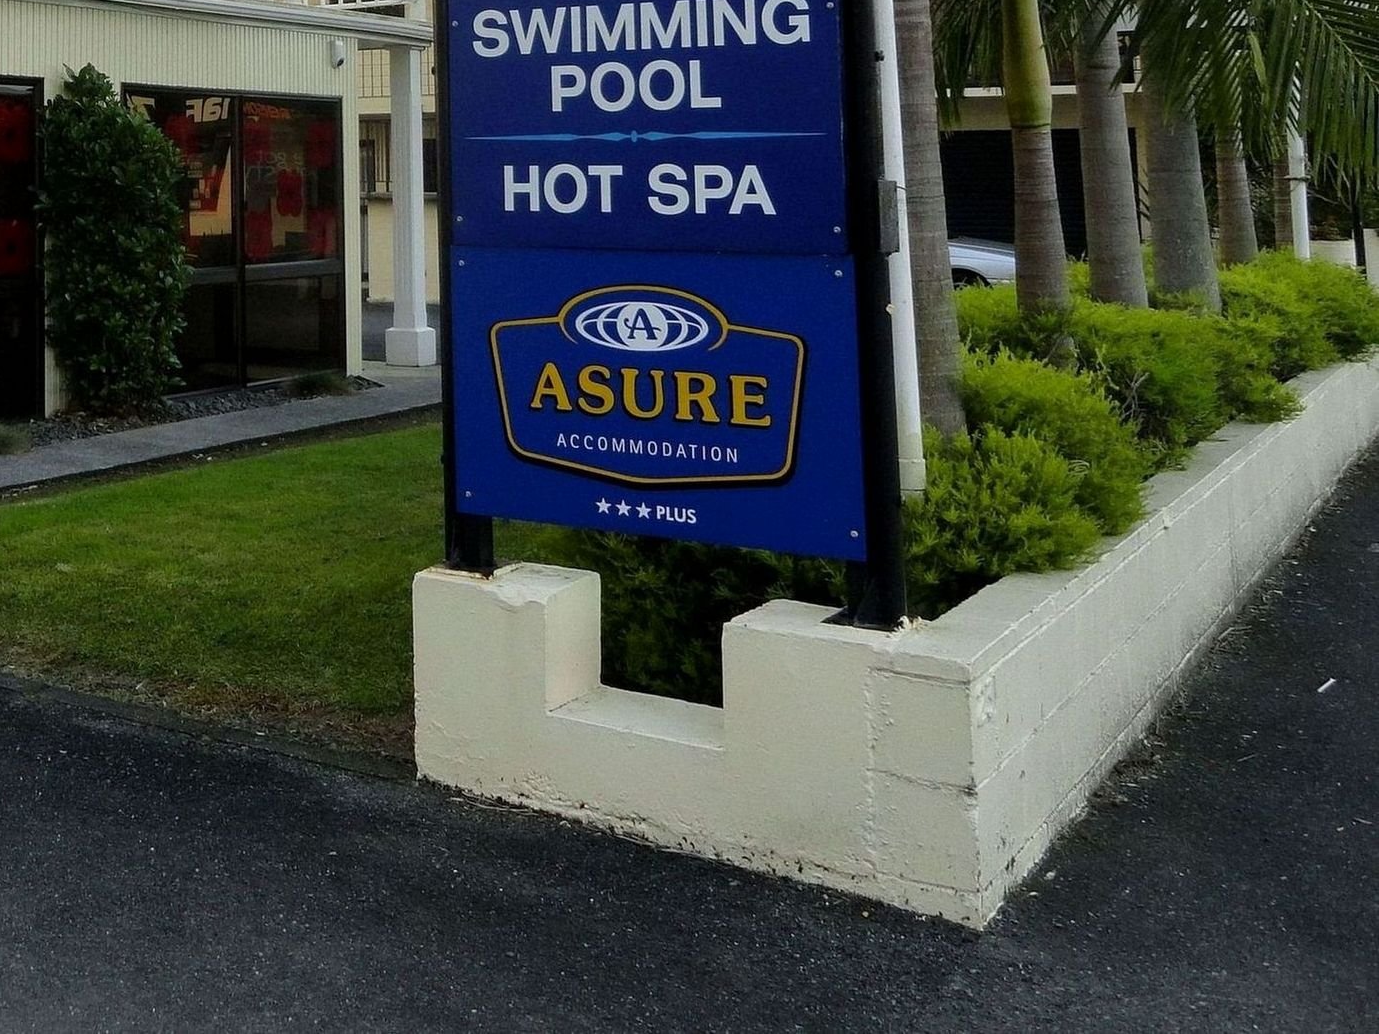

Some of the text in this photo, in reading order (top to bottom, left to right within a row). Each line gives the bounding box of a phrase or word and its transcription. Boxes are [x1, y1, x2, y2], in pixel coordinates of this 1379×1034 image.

[551, 59, 722, 113] POOL
[503, 163, 777, 215] HOT SPA
[530, 362, 772, 427] ASURE
[556, 433, 739, 464] ACCOMMODATION
[656, 504, 697, 524] PLUS
